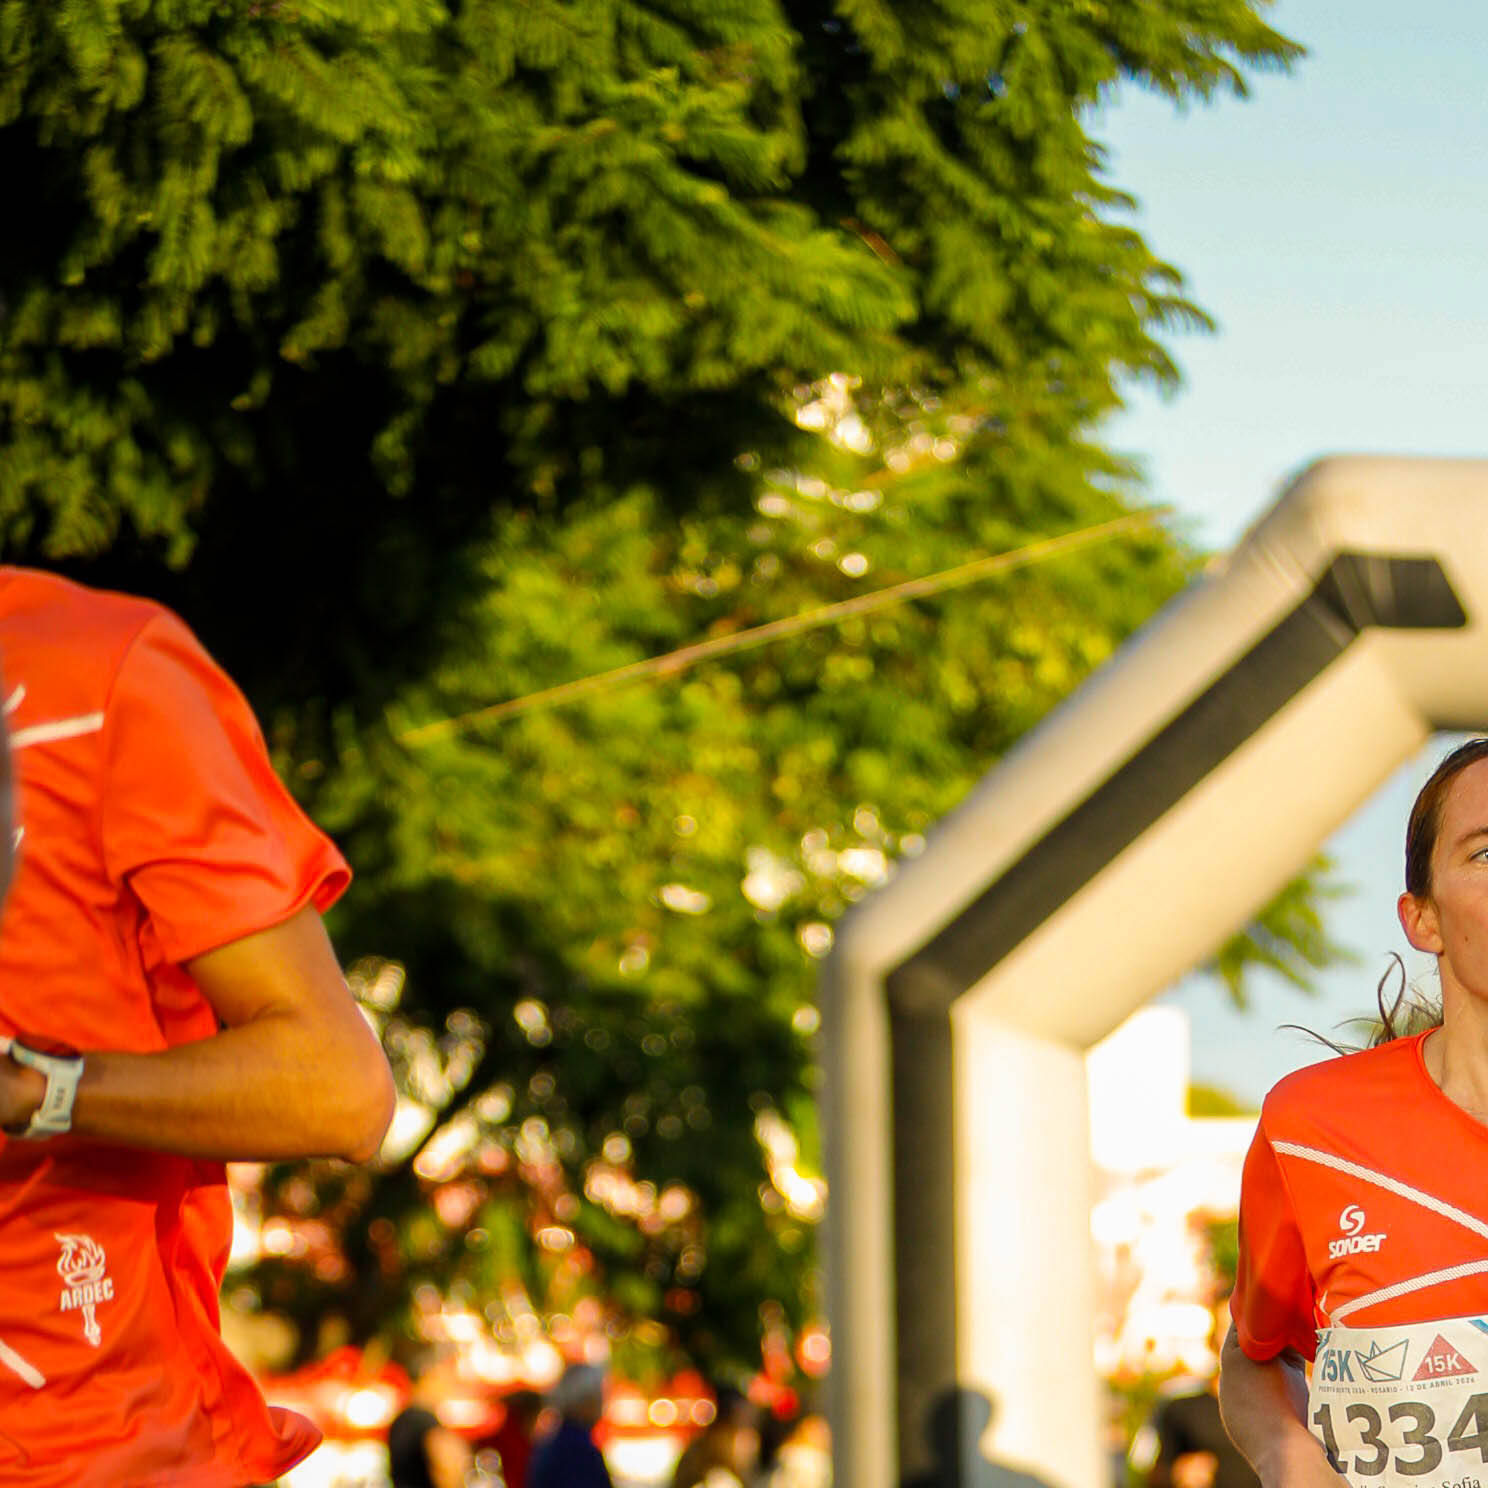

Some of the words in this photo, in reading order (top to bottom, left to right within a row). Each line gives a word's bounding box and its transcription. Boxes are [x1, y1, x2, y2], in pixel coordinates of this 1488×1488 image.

[60, 1277, 114, 1313] ARDEC
[1321, 1349, 1355, 1383] 15K
[1424, 1352, 1462, 1374] 15K
[1416, 1382, 1427, 1391] DE
